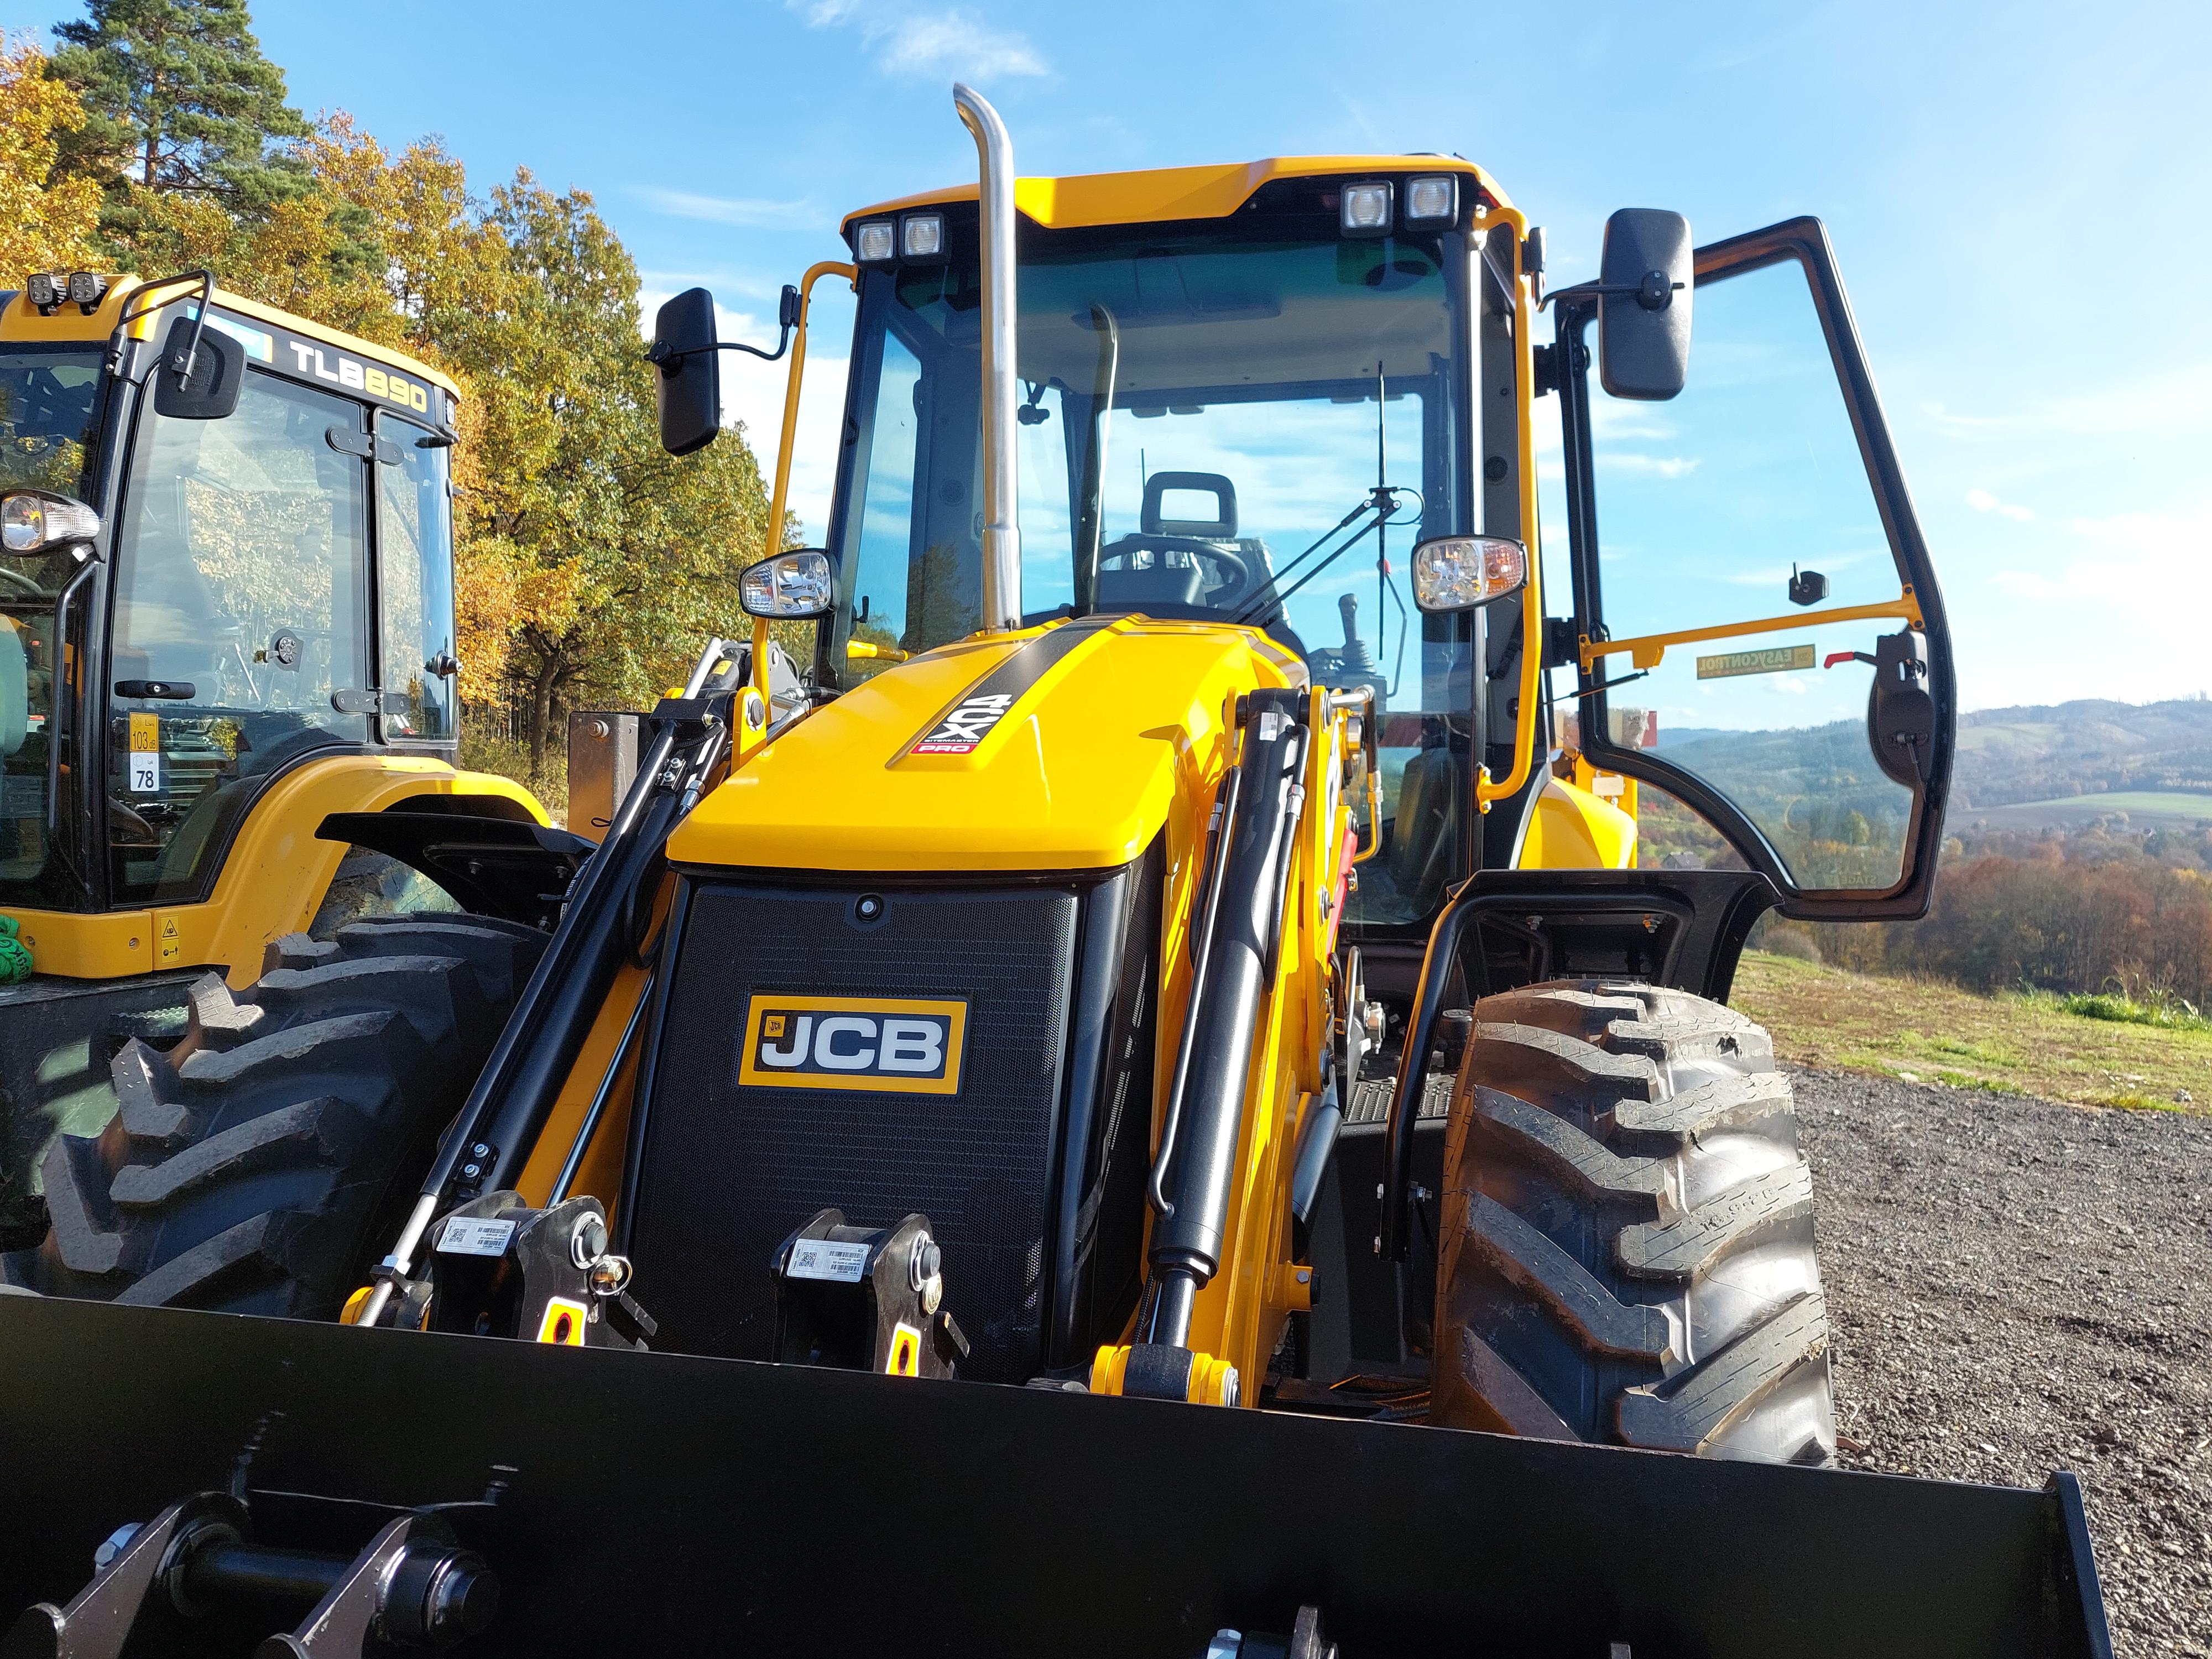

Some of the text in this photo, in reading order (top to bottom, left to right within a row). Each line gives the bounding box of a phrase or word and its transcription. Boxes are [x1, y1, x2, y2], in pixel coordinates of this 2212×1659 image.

[290, 341, 427, 413] TLB890
[927, 694, 1013, 739] 4CX
[133, 731, 156, 749] 103 dB
[136, 770, 154, 789] 78
[770, 1021, 781, 1031] JCB
[761, 1016, 942, 1072] JCB
